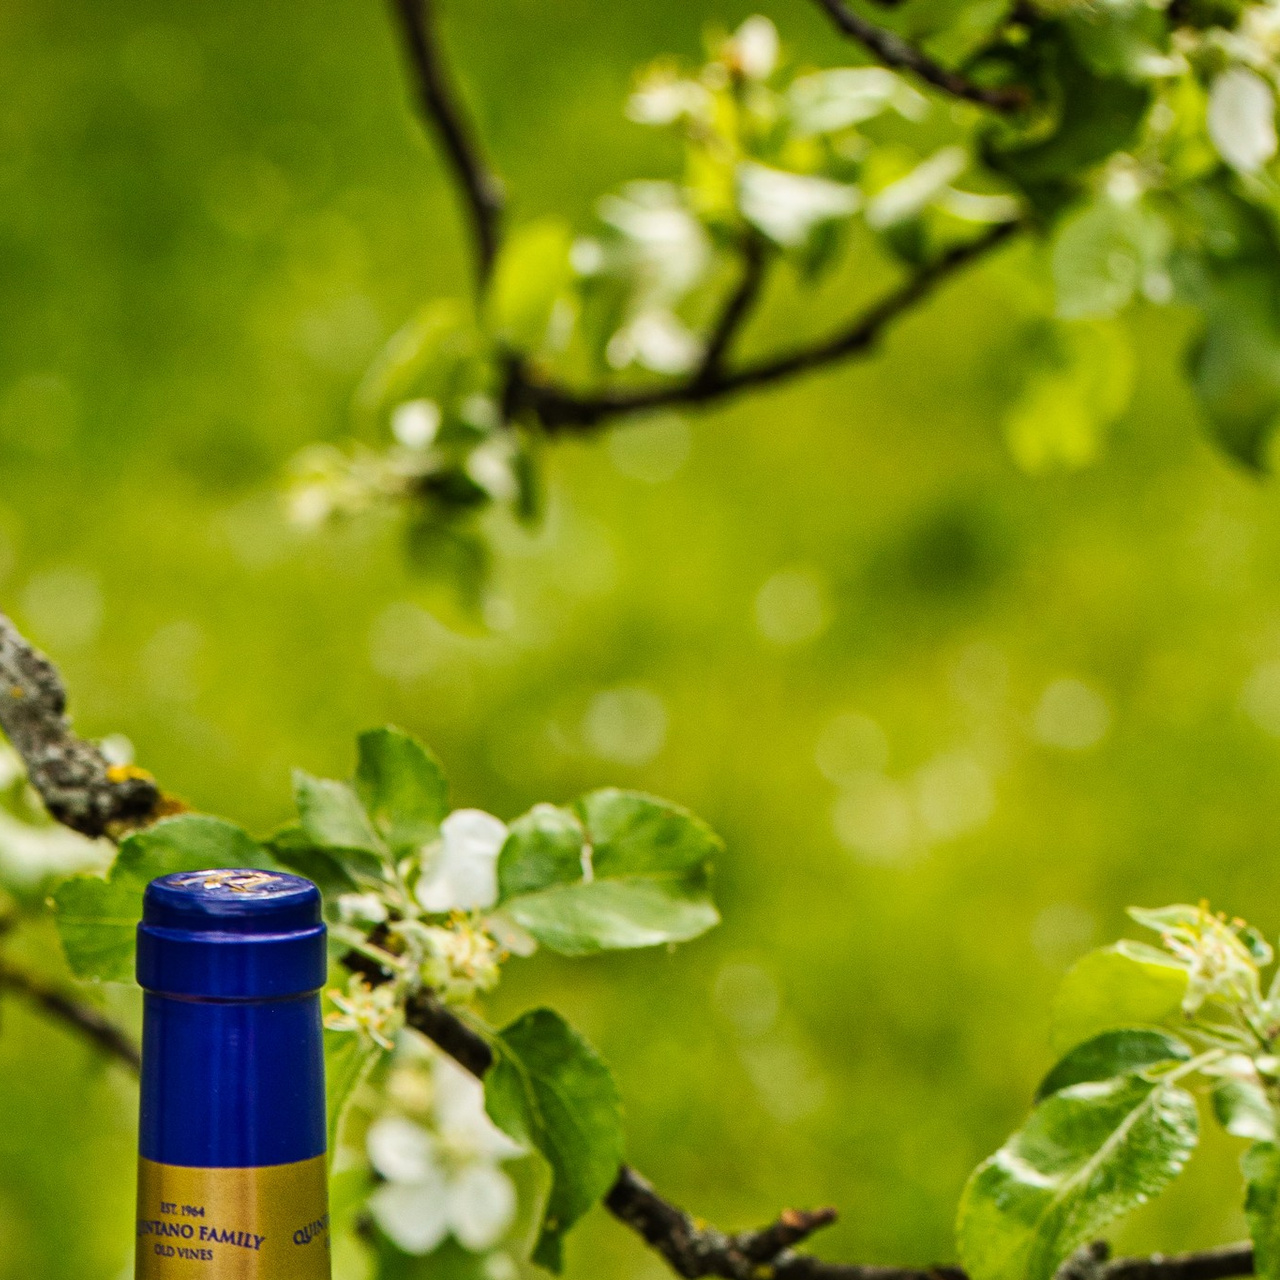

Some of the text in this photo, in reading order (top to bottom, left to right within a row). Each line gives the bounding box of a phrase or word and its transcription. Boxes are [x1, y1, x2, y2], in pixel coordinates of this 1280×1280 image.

[181, 1204, 205, 1218] 1964
[199, 1225, 265, 1251] FAMILY
[154, 1243, 213, 1261] OLD VINES
